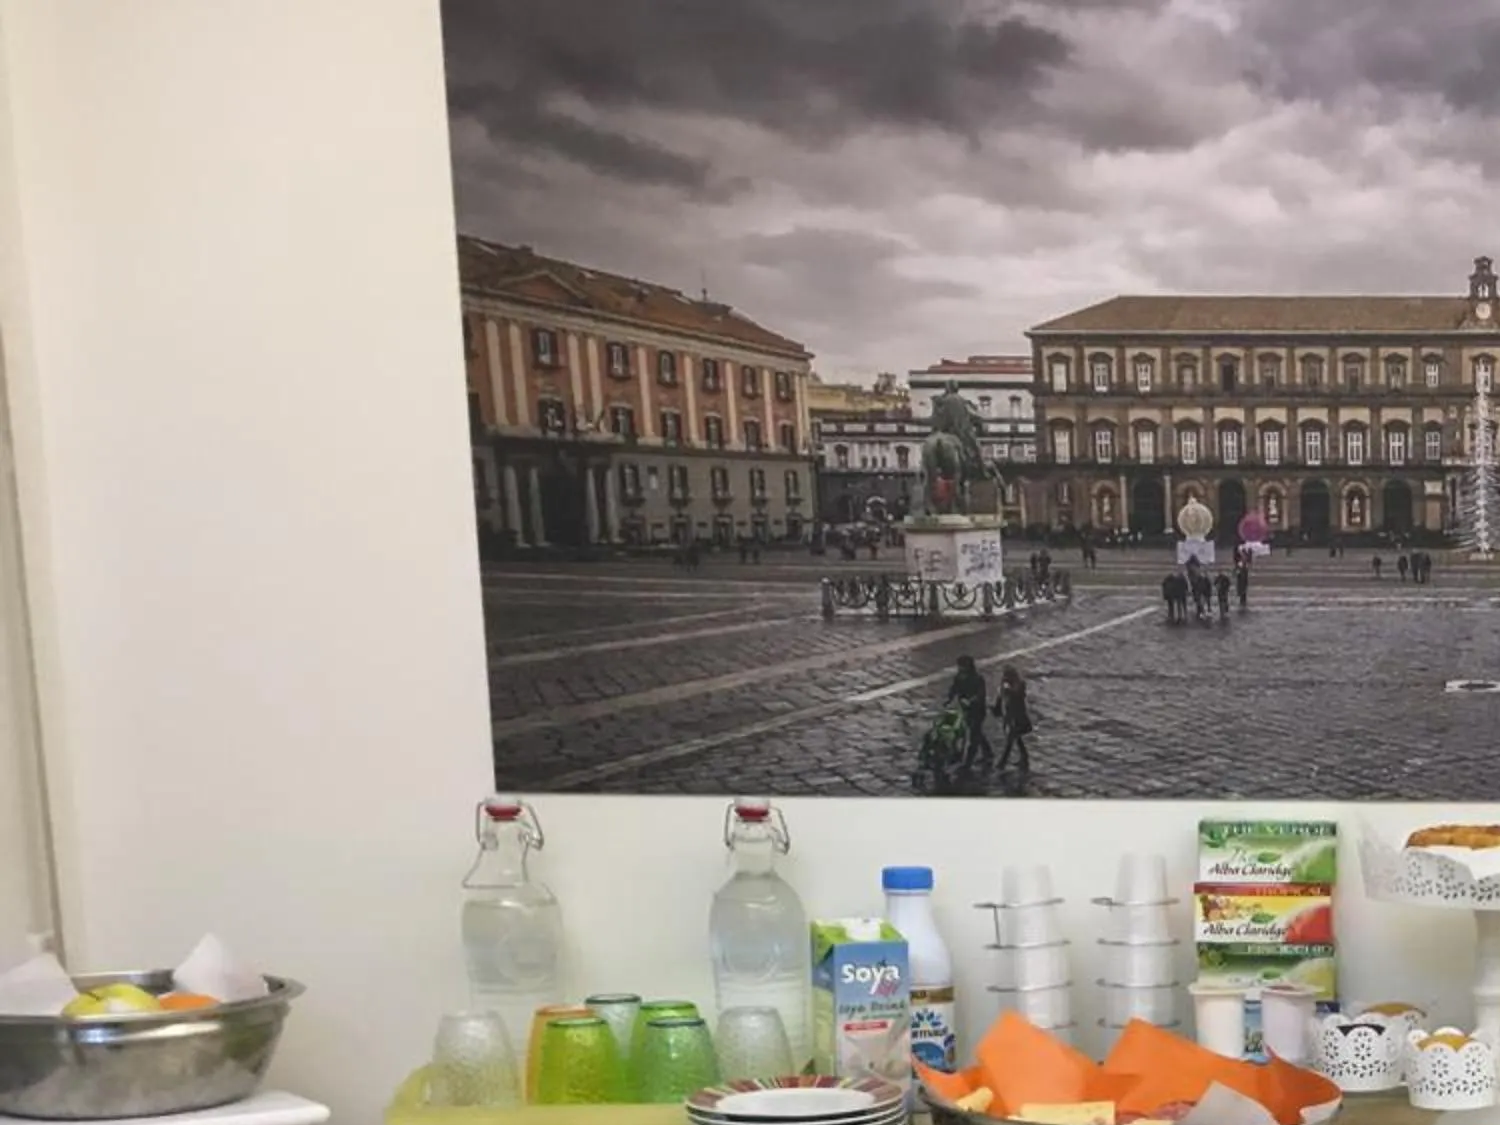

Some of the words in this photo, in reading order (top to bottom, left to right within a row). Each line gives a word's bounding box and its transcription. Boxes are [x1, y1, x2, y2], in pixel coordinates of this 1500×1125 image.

[1209, 863, 1240, 876] Alba
[1242, 863, 1294, 880] Claridge
[1203, 923, 1234, 935] Alba
[1236, 923, 1289, 940] Claridge
[842, 963, 899, 995] Soya
